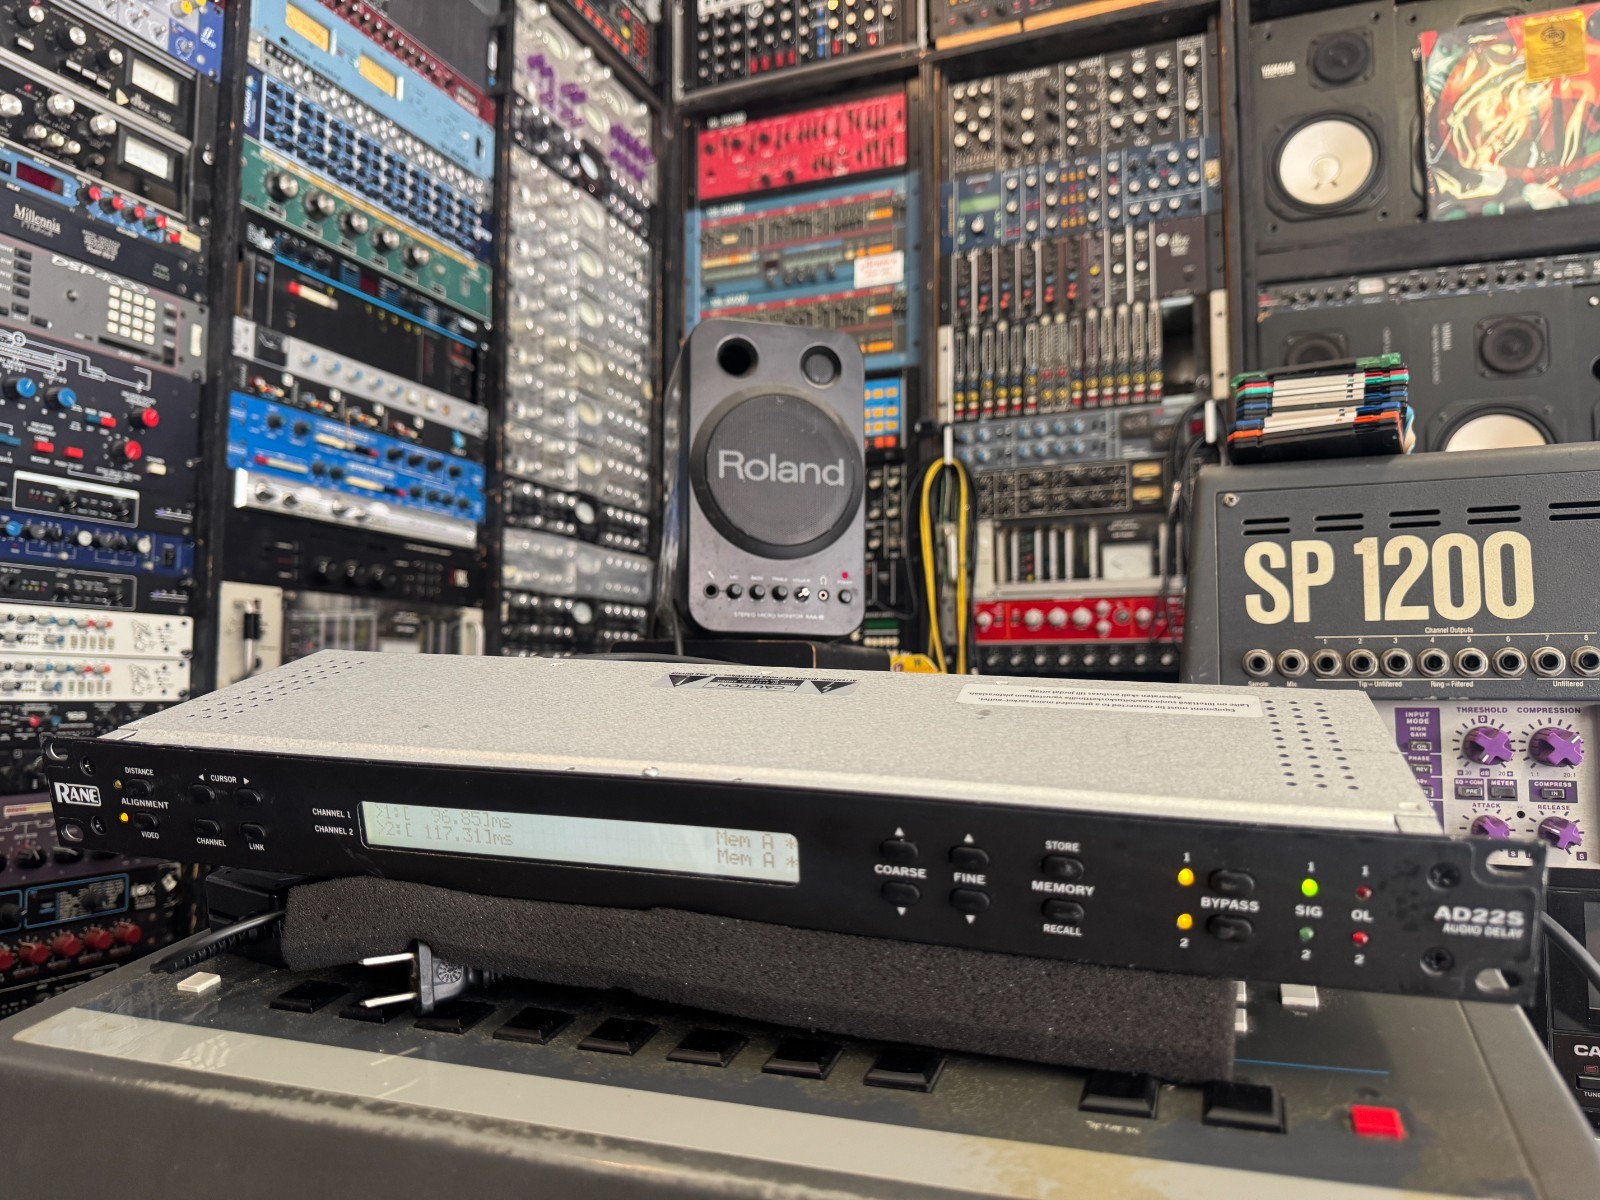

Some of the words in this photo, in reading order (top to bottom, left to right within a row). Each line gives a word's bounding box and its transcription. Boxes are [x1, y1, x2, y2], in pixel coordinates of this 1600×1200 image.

[13, 203, 61, 235] Millennia
[718, 449, 845, 487] Roland
[1243, 539, 1335, 625] SP
[1353, 530, 1535, 622] 1200
[1425, 626, 1449, 634] Channel
[1450, 626, 1474, 635] Outputs
[1358, 681, 1368, 689] Tip
[1431, 681, 1444, 689] Ring
[1456, 706, 1508, 714] THRESHOLD
[1516, 706, 1581, 714] COMPRESSION
[124, 766, 154, 777] DISTANCE
[210, 774, 237, 784] CURSOR
[55, 782, 100, 804] RANE
[121, 797, 170, 810] ALIGNMENT
[312, 807, 345, 818] CHANNEL
[140, 830, 160, 840] VIDEO
[314, 824, 347, 835] CHANNEL
[348, 827, 354, 836] 2
[196, 836, 227, 847] CHANNEL
[716, 830, 751, 848] Mem
[762, 834, 774, 850] A
[1045, 840, 1080, 852] STORE
[249, 842, 265, 852] LINK
[717, 849, 752, 866] Mem
[763, 852, 775, 869] A
[1183, 852, 1190, 862] 1
[874, 863, 927, 879] COARSE
[1307, 861, 1315, 873] 1
[1361, 865, 1369, 877] 1
[953, 872, 986, 885] FINE
[1031, 880, 1095, 897] MEMORY
[1200, 896, 1260, 913] BYPASS
[1295, 904, 1323, 918] SIG
[1351, 909, 1374, 923] OL
[1434, 905, 1524, 926] AD22S
[1043, 923, 1083, 937] RECALL
[1442, 922, 1482, 937] AUDIO
[1484, 925, 1523, 939] DELAY
[1179, 937, 1189, 948] 2
[1301, 949, 1311, 961] 2
[1354, 953, 1365, 966] 2
